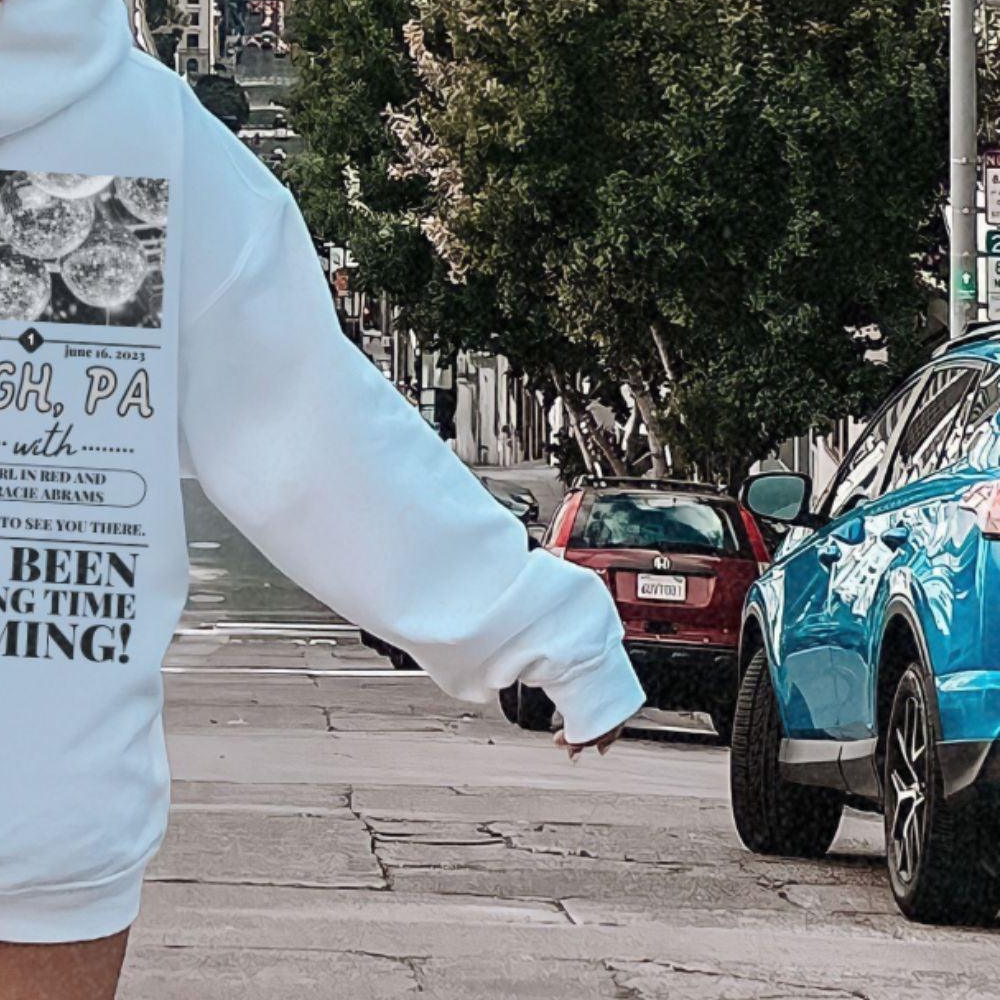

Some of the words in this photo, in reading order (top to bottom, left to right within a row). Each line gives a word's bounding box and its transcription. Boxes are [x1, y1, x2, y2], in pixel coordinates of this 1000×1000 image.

[115, 350, 145, 361] 2023
[84, 365, 154, 419] PA
[12, 421, 78, 457] with
[20, 468, 37, 481] IN
[40, 470, 71, 483] RED
[73, 472, 106, 485] AND
[43, 488, 104, 502] ABRAMS
[0, 516, 22, 529] TO
[25, 517, 53, 531] SEE
[56, 519, 88, 533] YOU
[90, 521, 146, 536] THERE.
[8, 546, 139, 588] BEEN
[43, 589, 136, 620] TIME
